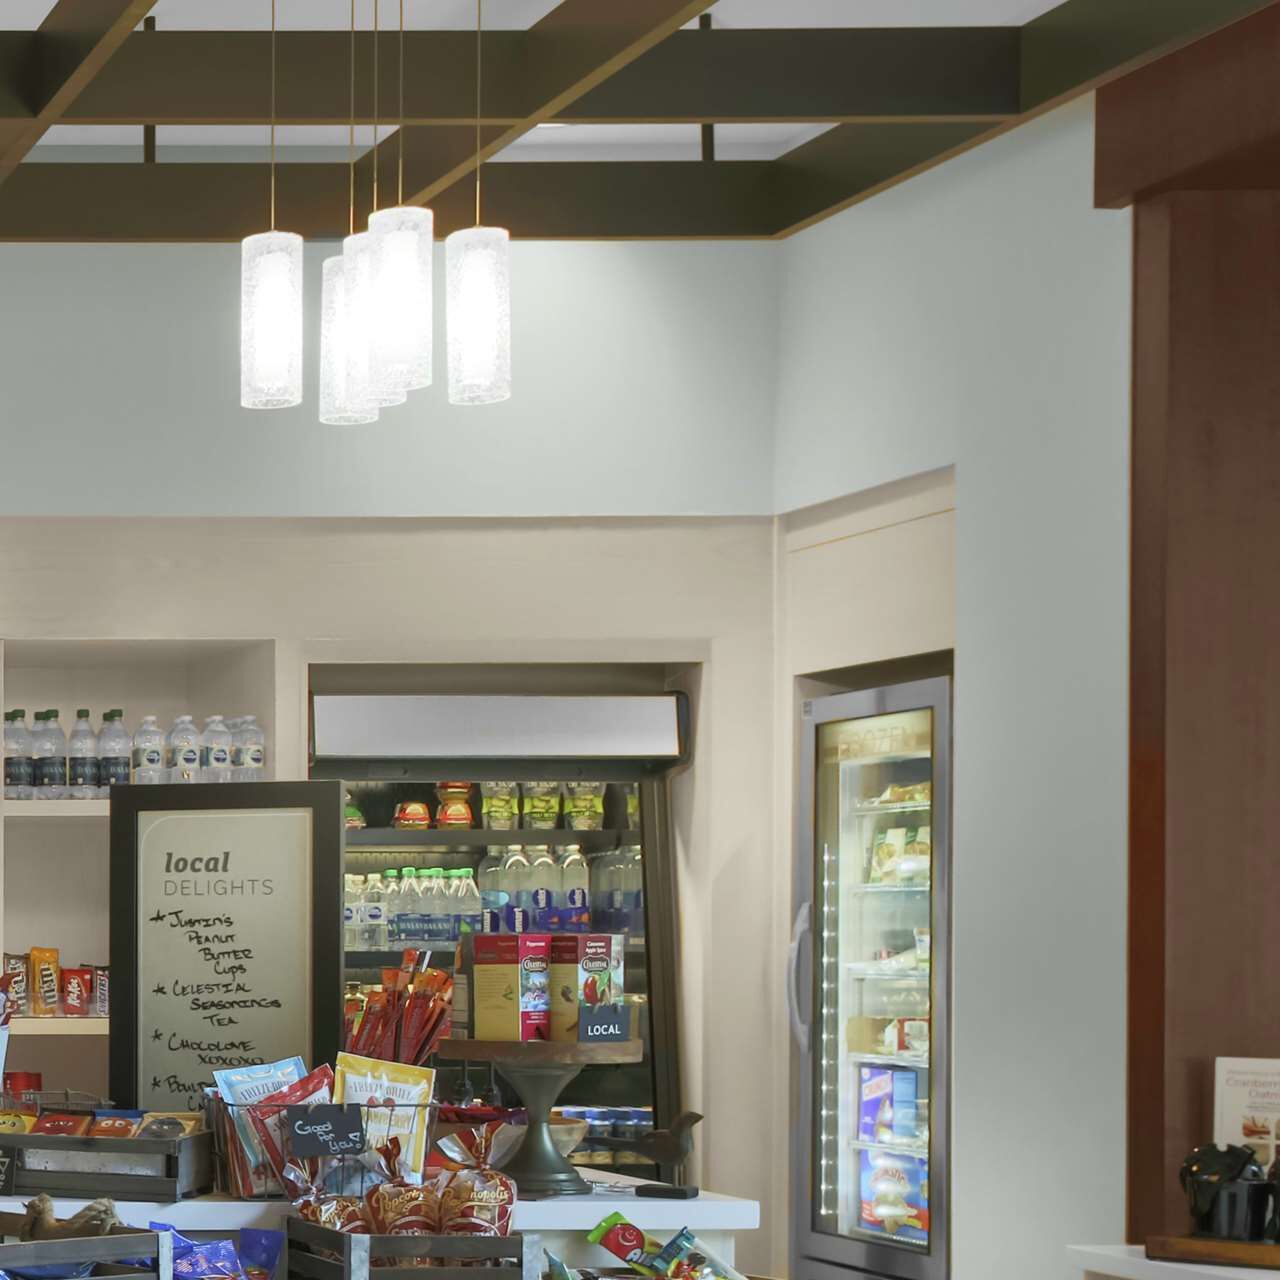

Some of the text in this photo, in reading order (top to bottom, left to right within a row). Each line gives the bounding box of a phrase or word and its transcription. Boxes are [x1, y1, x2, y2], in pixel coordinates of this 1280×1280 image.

[164, 851, 231, 873] local
[163, 878, 274, 896] DELIGHTS
[587, 1024, 621, 1036] LOCAL
[294, 1120, 333, 1136] Good
